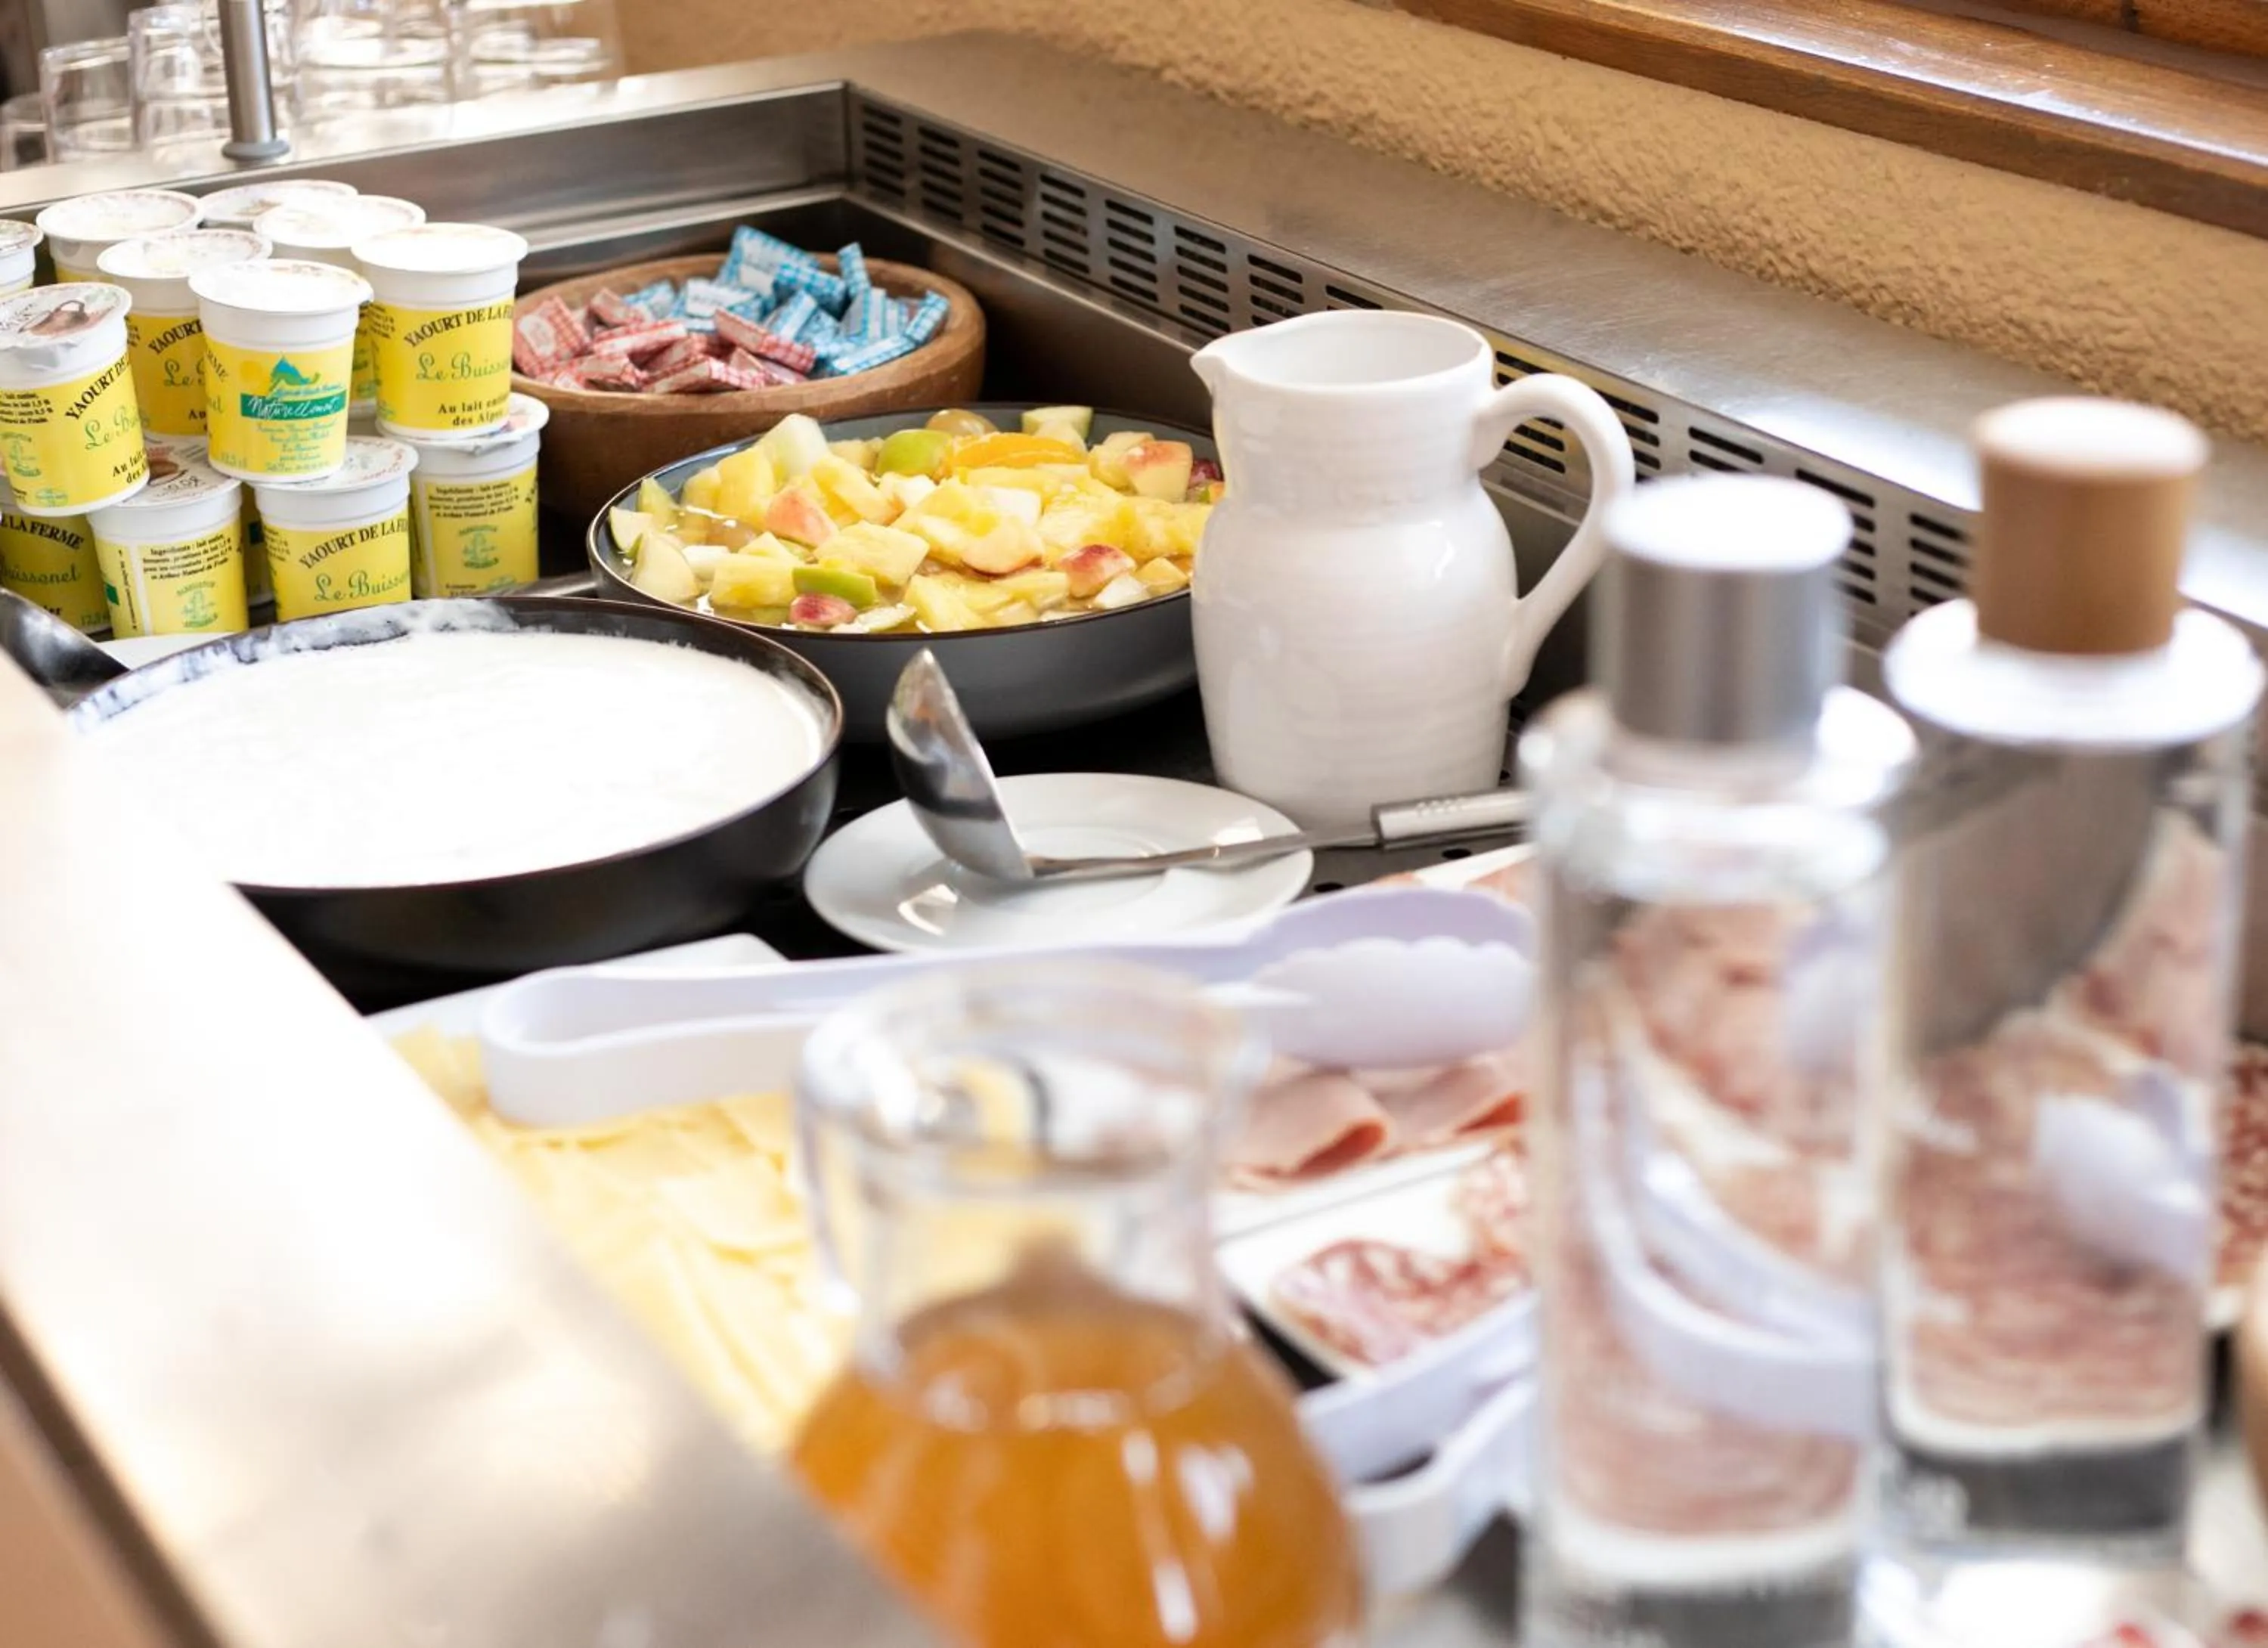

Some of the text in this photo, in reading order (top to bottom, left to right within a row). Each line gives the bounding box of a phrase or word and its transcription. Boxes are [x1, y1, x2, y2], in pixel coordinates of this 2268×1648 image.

[147, 318, 203, 355] YAOURT
[404, 314, 463, 348] YAOURT
[466, 308, 486, 325] DE
[163, 358, 191, 386] Le
[417, 352, 448, 381] Le
[65, 367, 116, 420] YAOURT
[438, 404, 456, 414] Au
[462, 401, 482, 413] lait
[84, 419, 110, 450] Le
[453, 416, 472, 426] des
[113, 465, 128, 478] Au
[9, 515, 27, 532] LA
[30, 521, 84, 550] FERME
[299, 532, 357, 569] YAOURT
[358, 524, 379, 542] DE
[314, 573, 344, 601] Le
